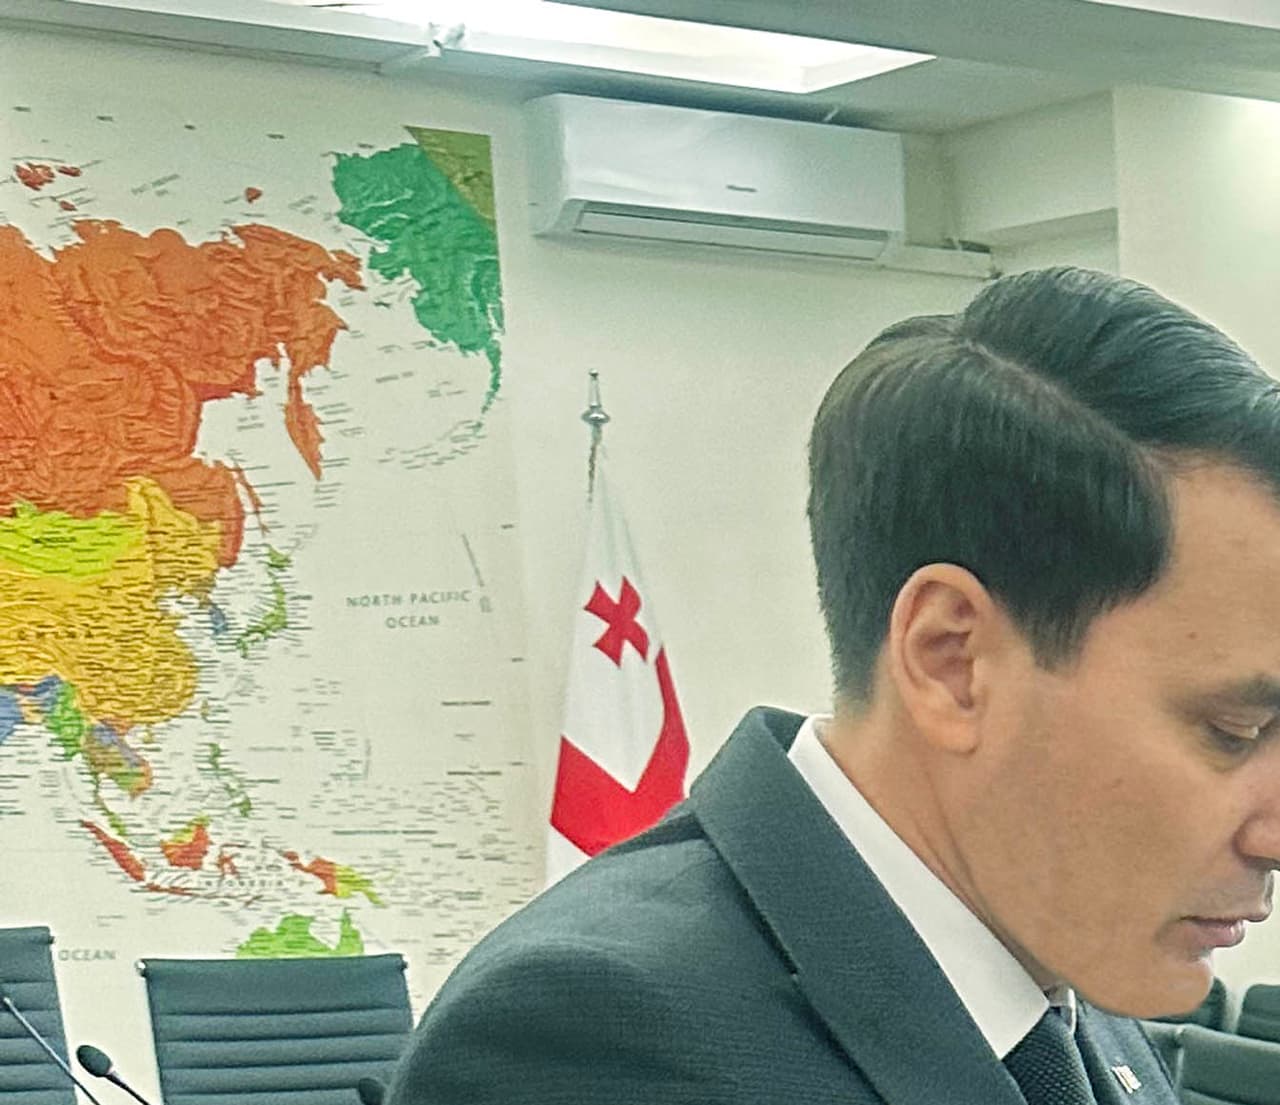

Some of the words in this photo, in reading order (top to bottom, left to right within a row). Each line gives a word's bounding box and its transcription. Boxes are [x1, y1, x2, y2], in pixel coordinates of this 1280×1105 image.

[346, 594, 402, 607] NORTH
[410, 590, 472, 604] PACIFIC
[385, 615, 440, 629] OCEAN
[58, 949, 117, 961] OCEAN
